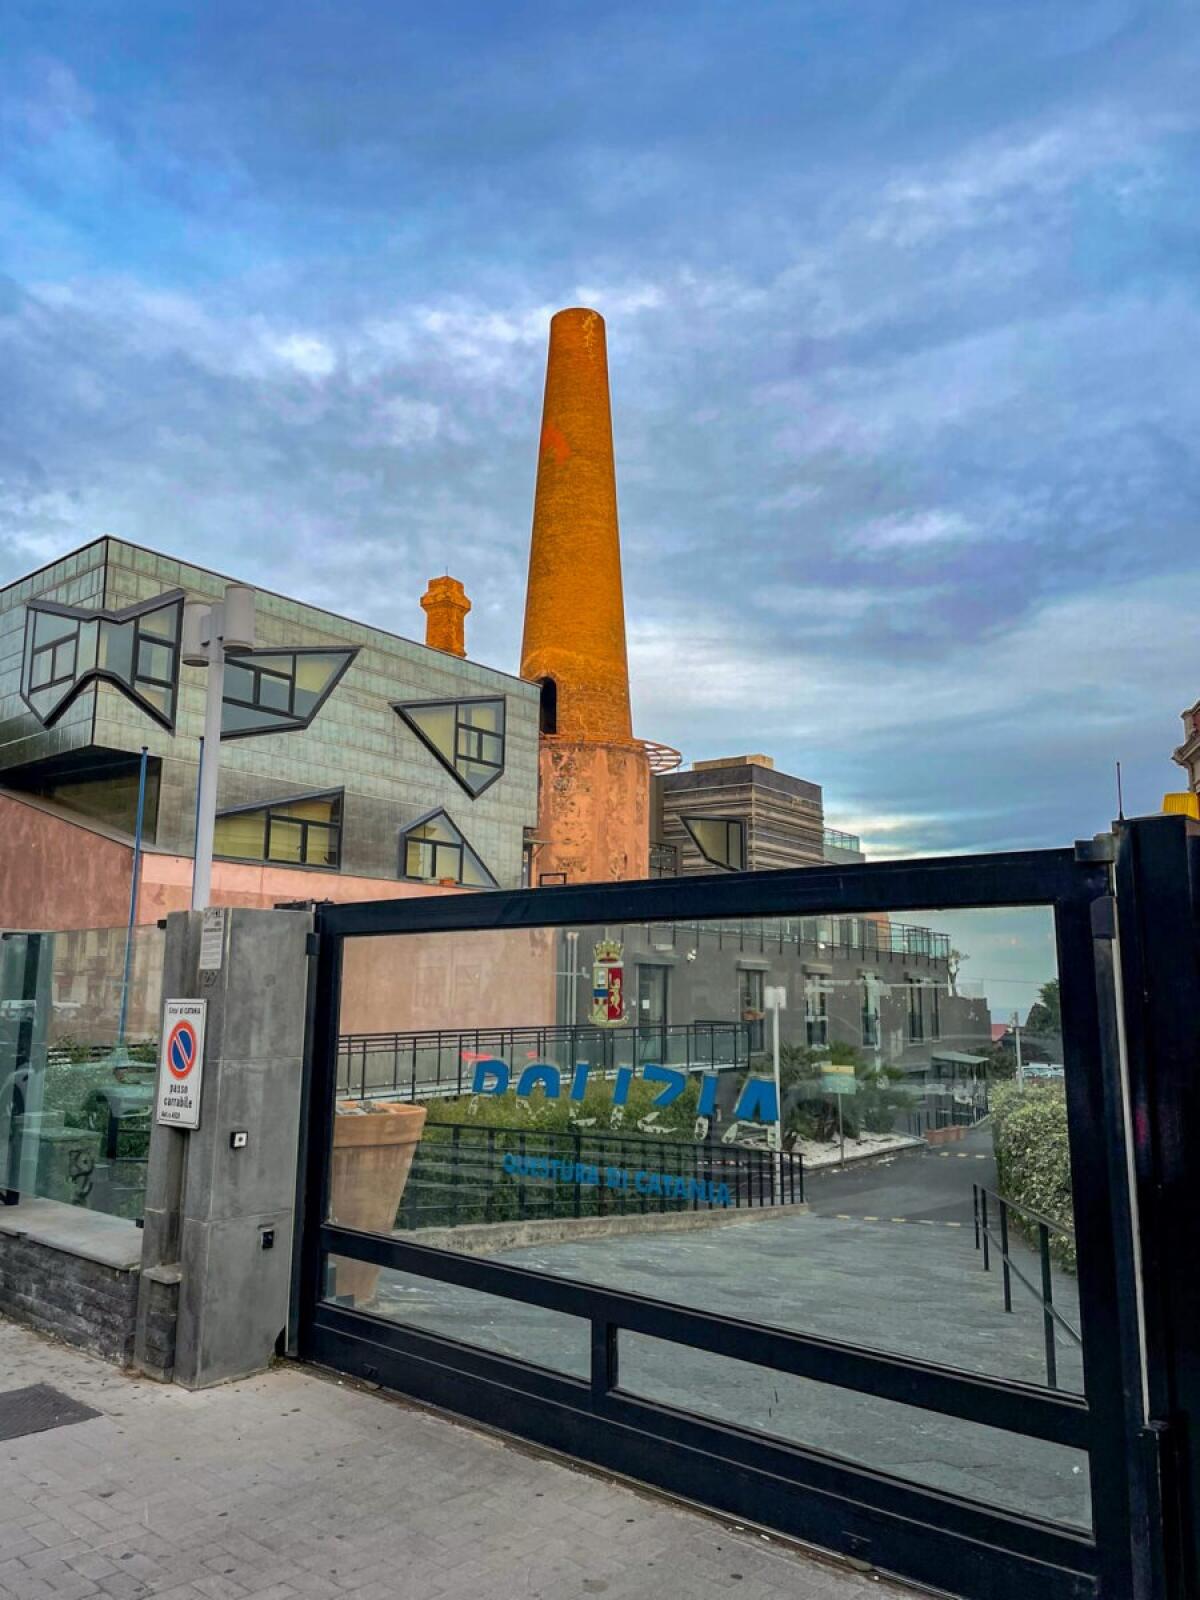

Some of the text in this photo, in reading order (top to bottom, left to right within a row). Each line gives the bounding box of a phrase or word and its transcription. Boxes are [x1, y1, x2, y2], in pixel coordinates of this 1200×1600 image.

[169, 1084, 189, 1094] passo
[163, 1096, 193, 1108] carrabile
[503, 1152, 732, 1206] QUESTURA DI CATANIA
